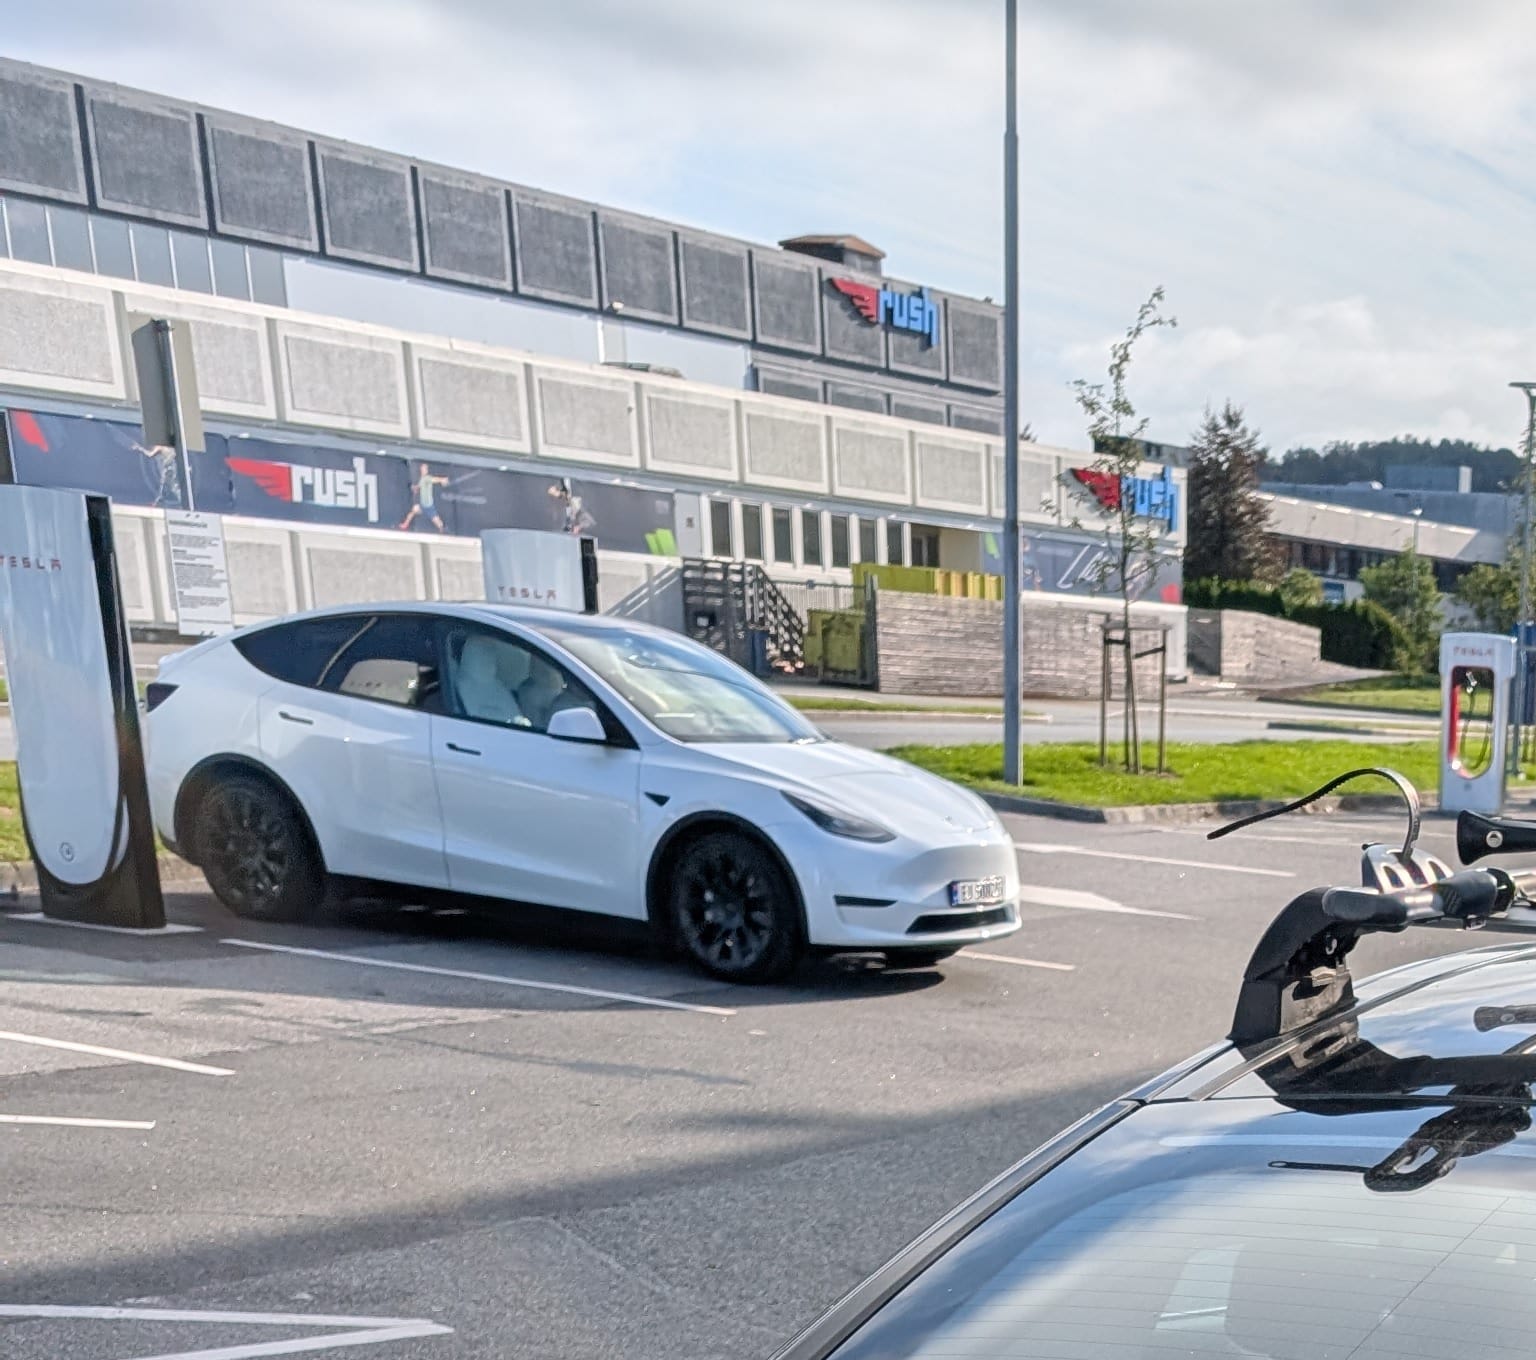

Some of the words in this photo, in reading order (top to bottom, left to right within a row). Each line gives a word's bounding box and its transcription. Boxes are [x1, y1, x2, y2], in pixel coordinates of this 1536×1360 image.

[879, 287, 939, 347] rush
[291, 456, 379, 523] rush
[498, 586, 557, 600] TESLA
